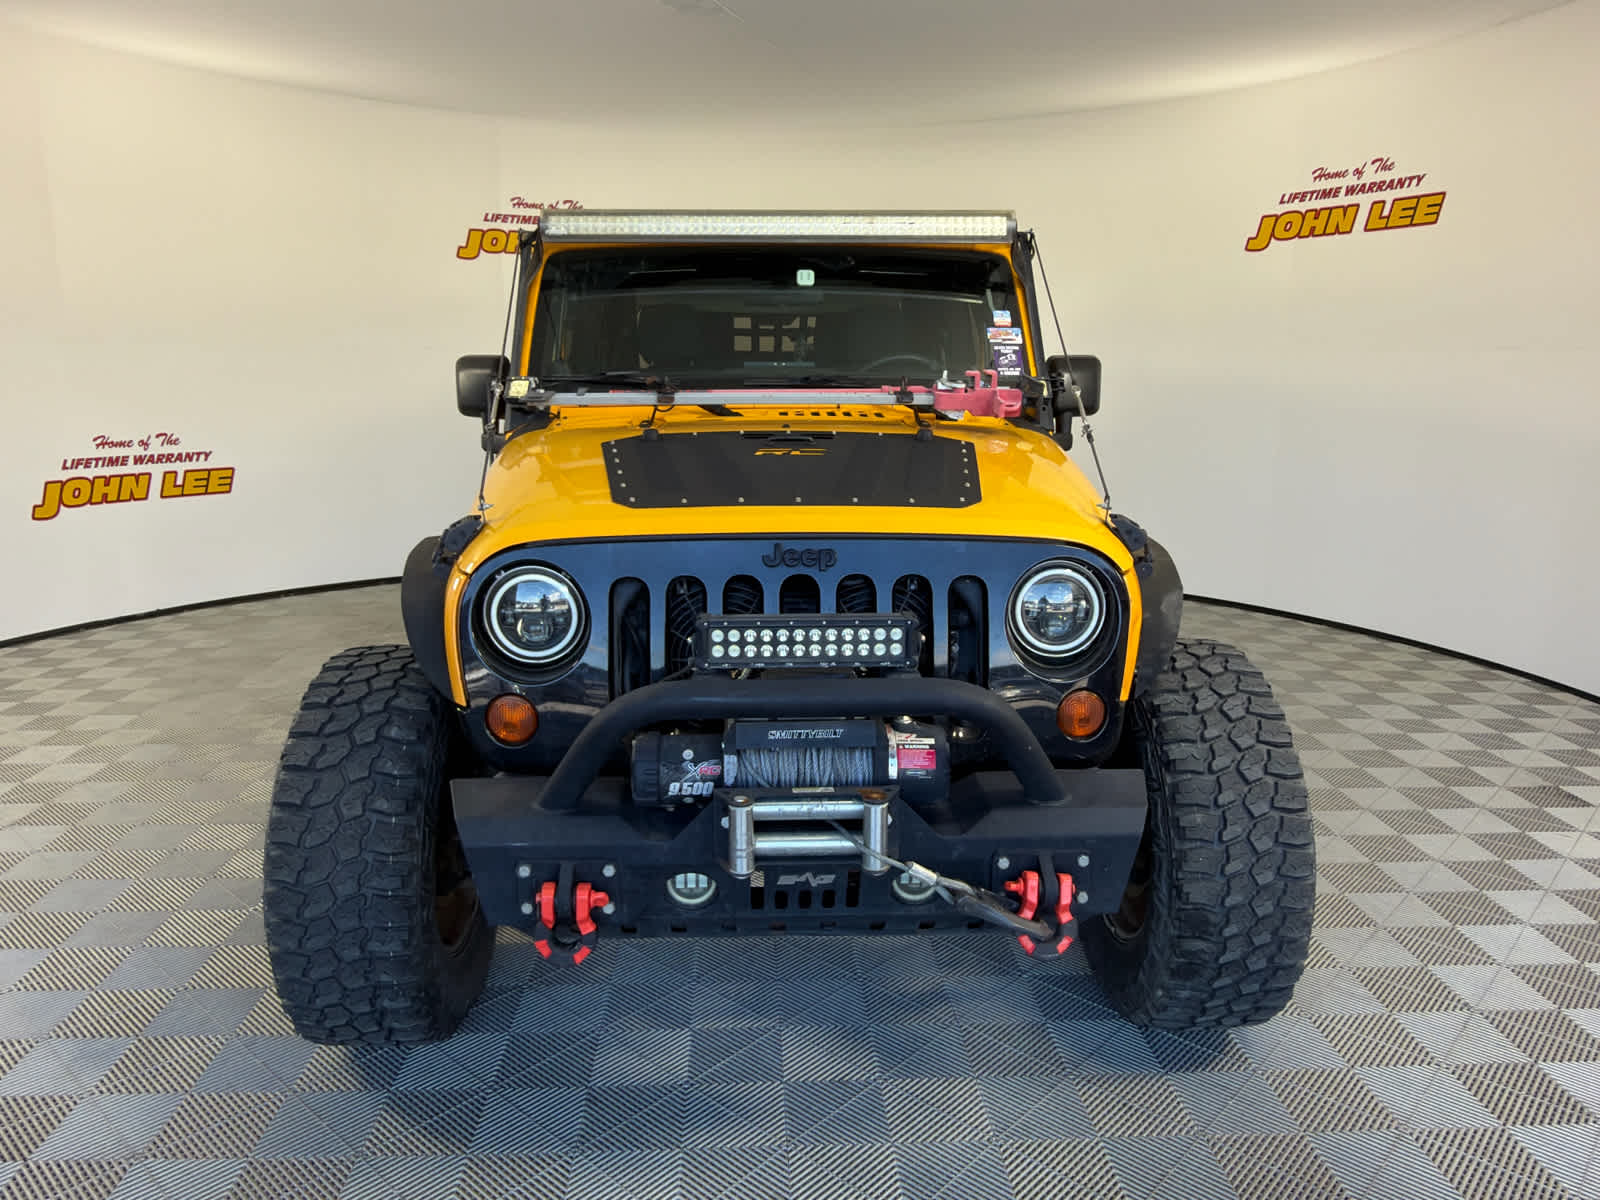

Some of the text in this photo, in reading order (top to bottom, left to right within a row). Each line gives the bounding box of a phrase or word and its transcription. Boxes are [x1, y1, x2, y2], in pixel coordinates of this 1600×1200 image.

[1312, 157, 1395, 183] Home of The
[1279, 173, 1427, 205] LIFETIME WARRANTY
[510, 196, 544, 209] Home
[483, 213, 540, 225] LIFETIME
[1244, 191, 1446, 252] JOHN LEE
[92, 432, 181, 451] Home of The
[61, 451, 213, 470] LIFETIME WARRANTY
[32, 467, 235, 521] JOHN LEE
[761, 542, 838, 572] Jeep
[768, 728, 844, 740] SMITTYBILT
